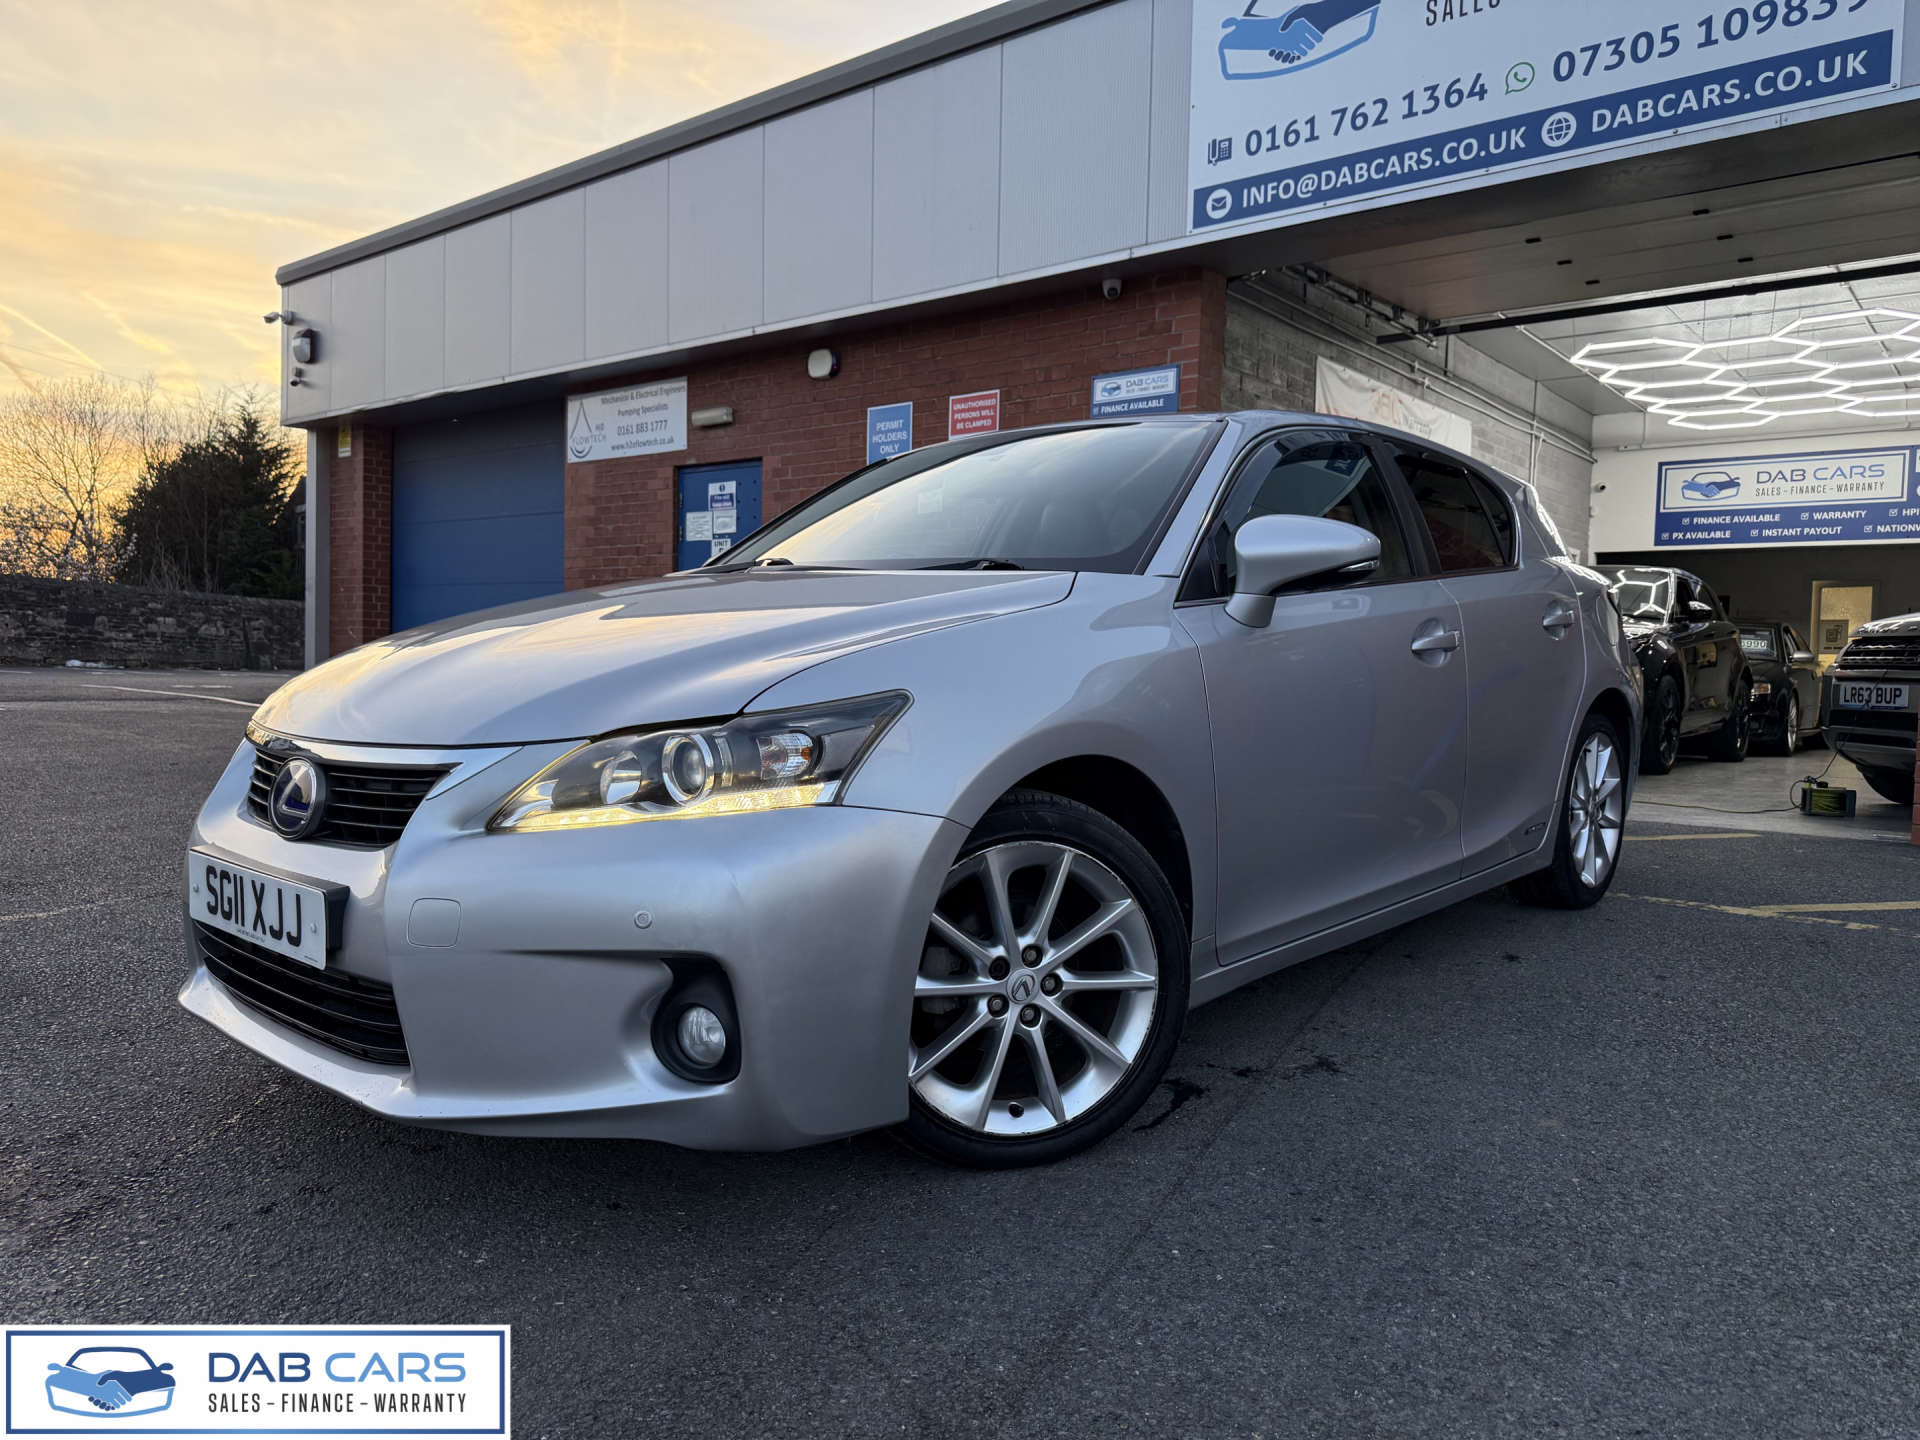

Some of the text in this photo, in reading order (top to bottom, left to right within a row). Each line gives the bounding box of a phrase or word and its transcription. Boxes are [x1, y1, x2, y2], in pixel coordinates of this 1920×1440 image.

[1552, 24, 1680, 82] 07305
[1592, 50, 1868, 132] DABCARS.CO.UK
[1245, 72, 1488, 156] 0161 762 1364
[1242, 126, 1526, 208] INFO@DABCARS.CO.UK
[1101, 399, 1164, 414] FINANCE AVAILABLE
[954, 411, 980, 419] PERSONS
[651, 419, 668, 432] 1777
[876, 420, 904, 431] PERMIT
[965, 419, 992, 428] CLAMPED
[872, 431, 908, 444] HOLDERS
[880, 443, 899, 454] ONLY
[1756, 464, 1885, 484] DAB CARS
[1755, 486, 1781, 497] SALES
[1790, 484, 1827, 496] FINANCE
[1836, 481, 1885, 493] WARRANTY
[1693, 513, 1780, 525] FINANCE AVAILABLE
[1813, 510, 1867, 520] WARRANTY
[1672, 530, 1731, 540] PX AVAILABLE
[1762, 526, 1842, 537] INSTANT PAYOUT
[1843, 686, 1903, 704] LR63 BUP
[251, 879, 302, 947] XJJ
